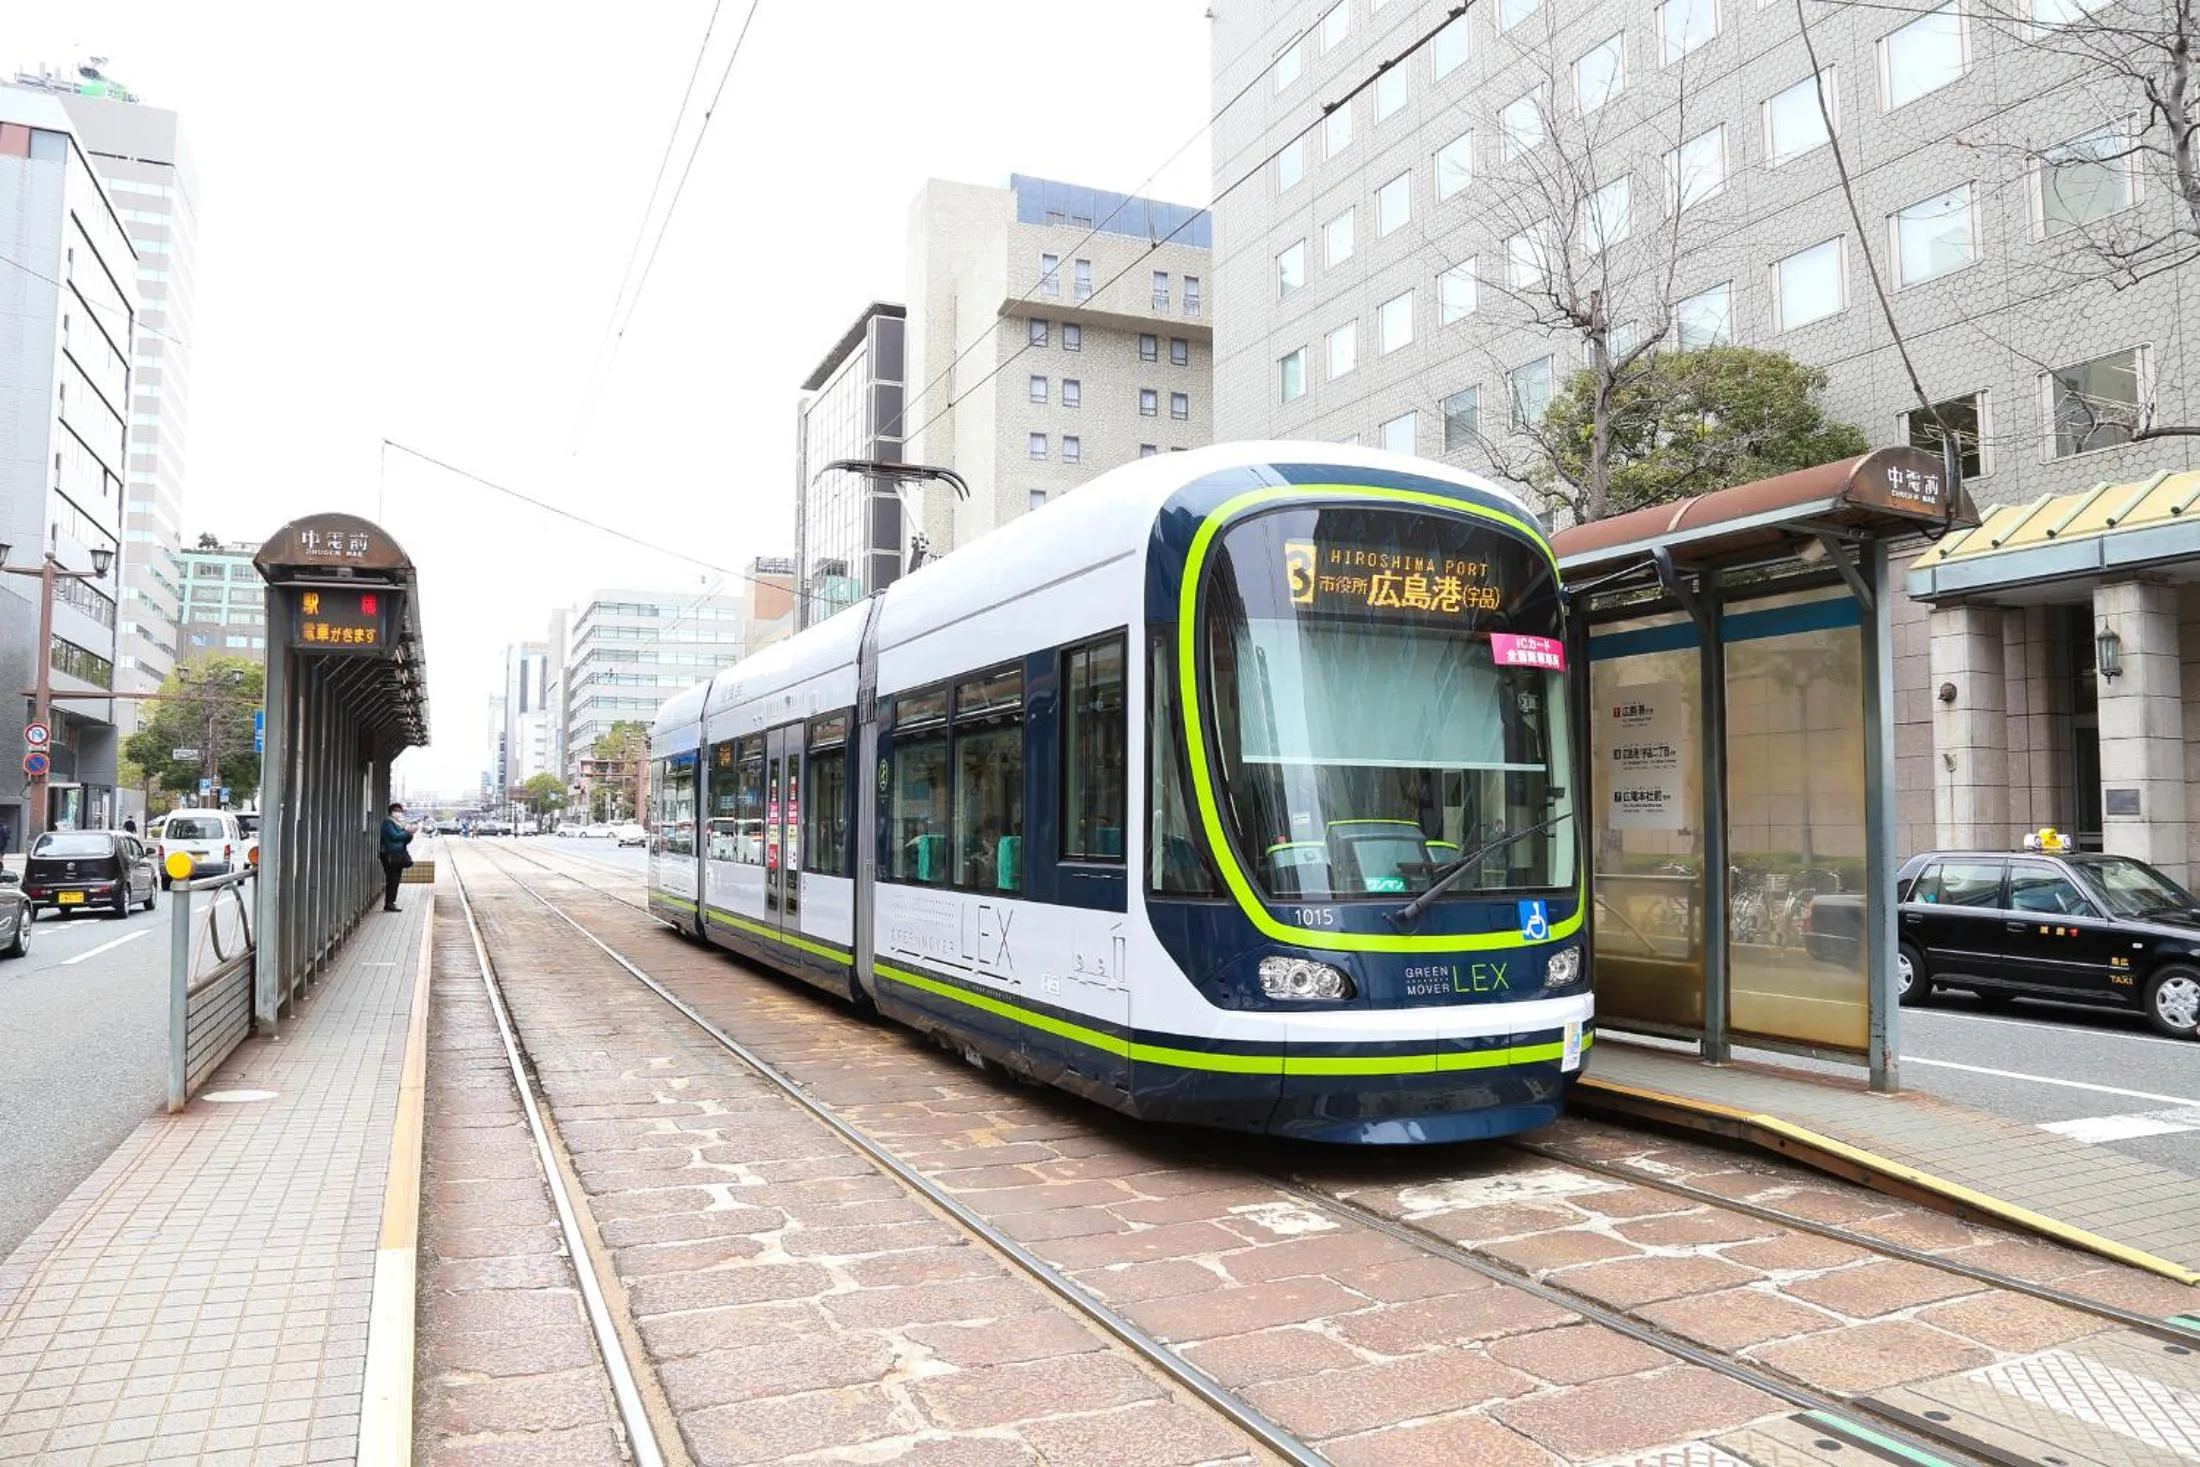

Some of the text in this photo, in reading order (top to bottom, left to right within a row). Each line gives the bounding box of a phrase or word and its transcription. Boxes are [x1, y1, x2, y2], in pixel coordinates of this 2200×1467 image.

[302, 530, 369, 551] 中電前
[1331, 549, 1489, 578] HIROSHIMA PORT
[1286, 551, 1314, 601] 3
[1318, 575, 1368, 595] 市役所
[303, 622, 376, 643] 電車がきます
[1515, 637, 1551, 651] ICカード
[1295, 908, 1334, 925] 1015
[961, 902, 1015, 970] LEX
[1405, 962, 1510, 993] GREEN LEX
[1407, 983, 1450, 996] MOVER
